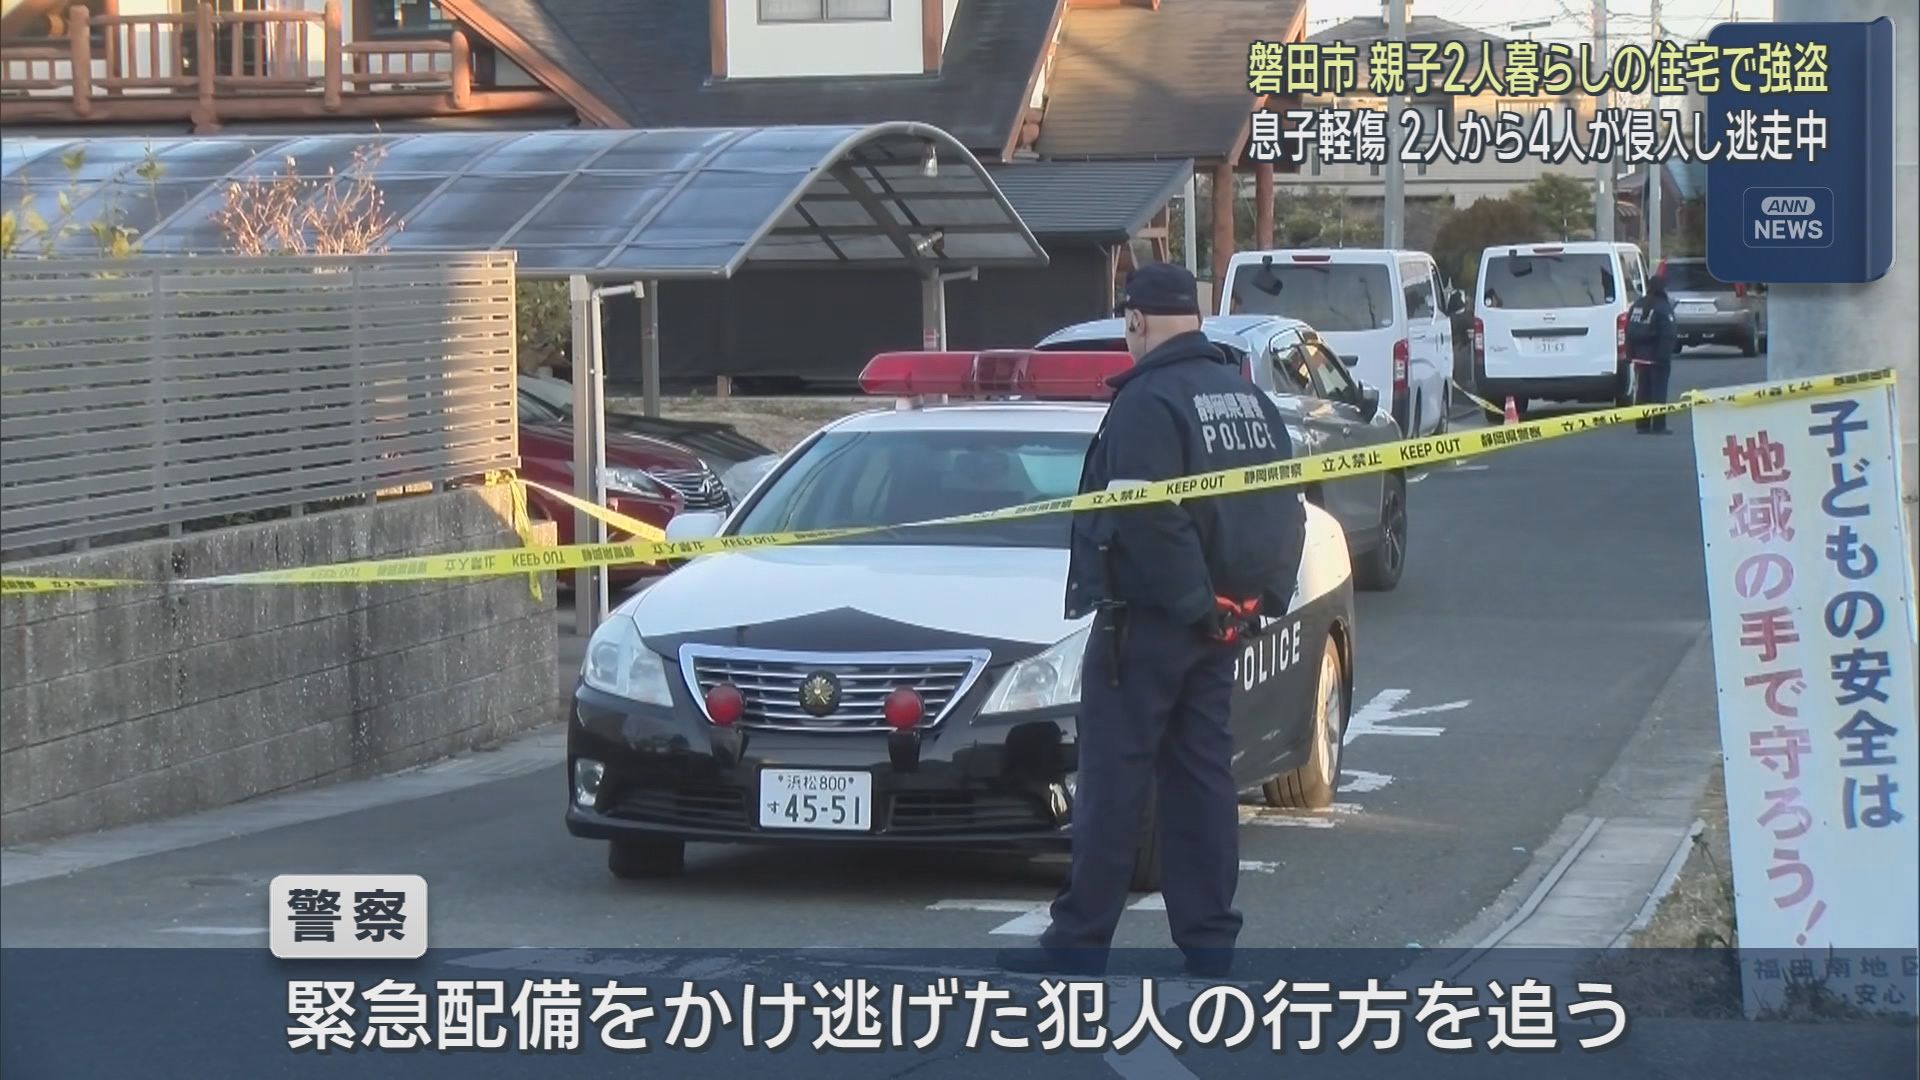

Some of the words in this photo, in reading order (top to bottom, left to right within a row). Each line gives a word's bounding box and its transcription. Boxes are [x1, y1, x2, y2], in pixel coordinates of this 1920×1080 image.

[1092, 488, 1148, 504] 立入禁止
[1166, 478, 1198, 495] KEEP
[1200, 475, 1226, 491] OUT
[1244, 463, 1302, 485] 静岡県警察
[1321, 450, 1382, 473] 立入禁止
[1400, 442, 1432, 460] KEEP
[1436, 438, 1461, 455] OUT
[1481, 426, 1543, 448] 静岡県警察
[1808, 400, 1903, 829] 子どもの安全は
[1722, 430, 1827, 946] 地域の手で守ろう！
[785, 794, 860, 824] 45-51
[787, 775, 847, 791] 浜松800
